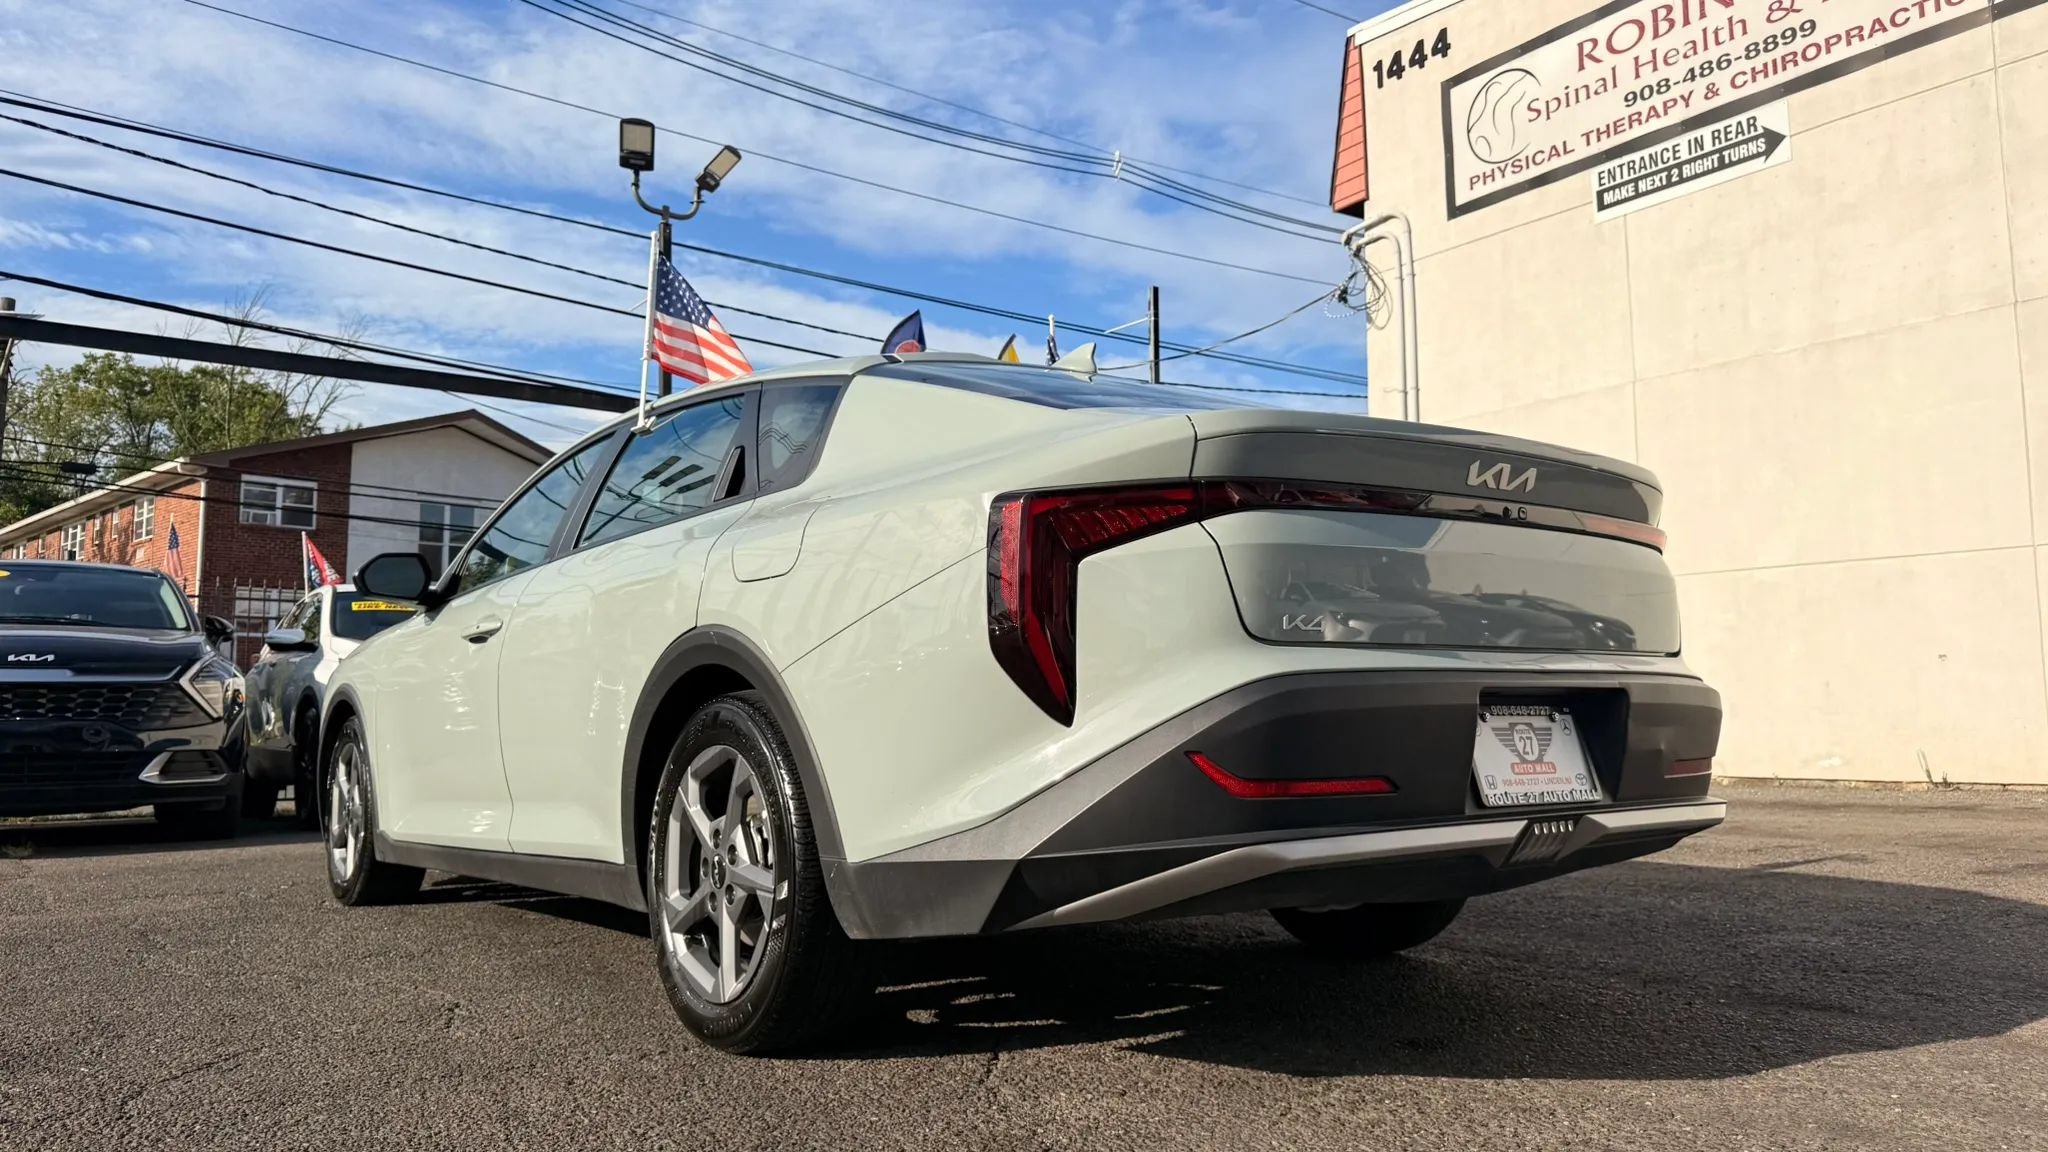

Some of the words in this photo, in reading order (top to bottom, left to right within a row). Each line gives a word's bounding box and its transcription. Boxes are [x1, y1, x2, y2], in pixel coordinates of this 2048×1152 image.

[1372, 27, 1452, 89] 1444
[1526, 65, 1619, 123] Spinal
[1632, 15, 1749, 80] Health
[1765, 0, 1804, 24] &
[1623, 18, 1817, 108] 908-486-8899
[1469, 140, 1576, 190] PHYSICAL
[1581, 90, 1694, 147] THERAPY
[1703, 82, 1721, 101] &
[1597, 143, 1682, 187] ENTRANCE
[1687, 134, 1705, 156] IN
[1711, 115, 1759, 147] REAR
[1602, 186, 1636, 206] MAKE
[1638, 172, 1669, 193] NEXT
[1671, 167, 1680, 182] 2
[1682, 154, 1720, 179] RIGHT
[1722, 137, 1767, 165] TURNS
[1467, 459, 1537, 493] KIA
[1282, 614, 1325, 632] K4
[8, 653, 55, 662] KIA
[1513, 763, 1533, 773] AUTO
[1535, 762, 1555, 773] MALL
[1518, 735, 1534, 756] 27
[1488, 792, 1524, 806] ROUTE
[1528, 792, 1540, 803] 27
[1543, 790, 1571, 802] AUTO
[1573, 789, 1600, 801] MALL
